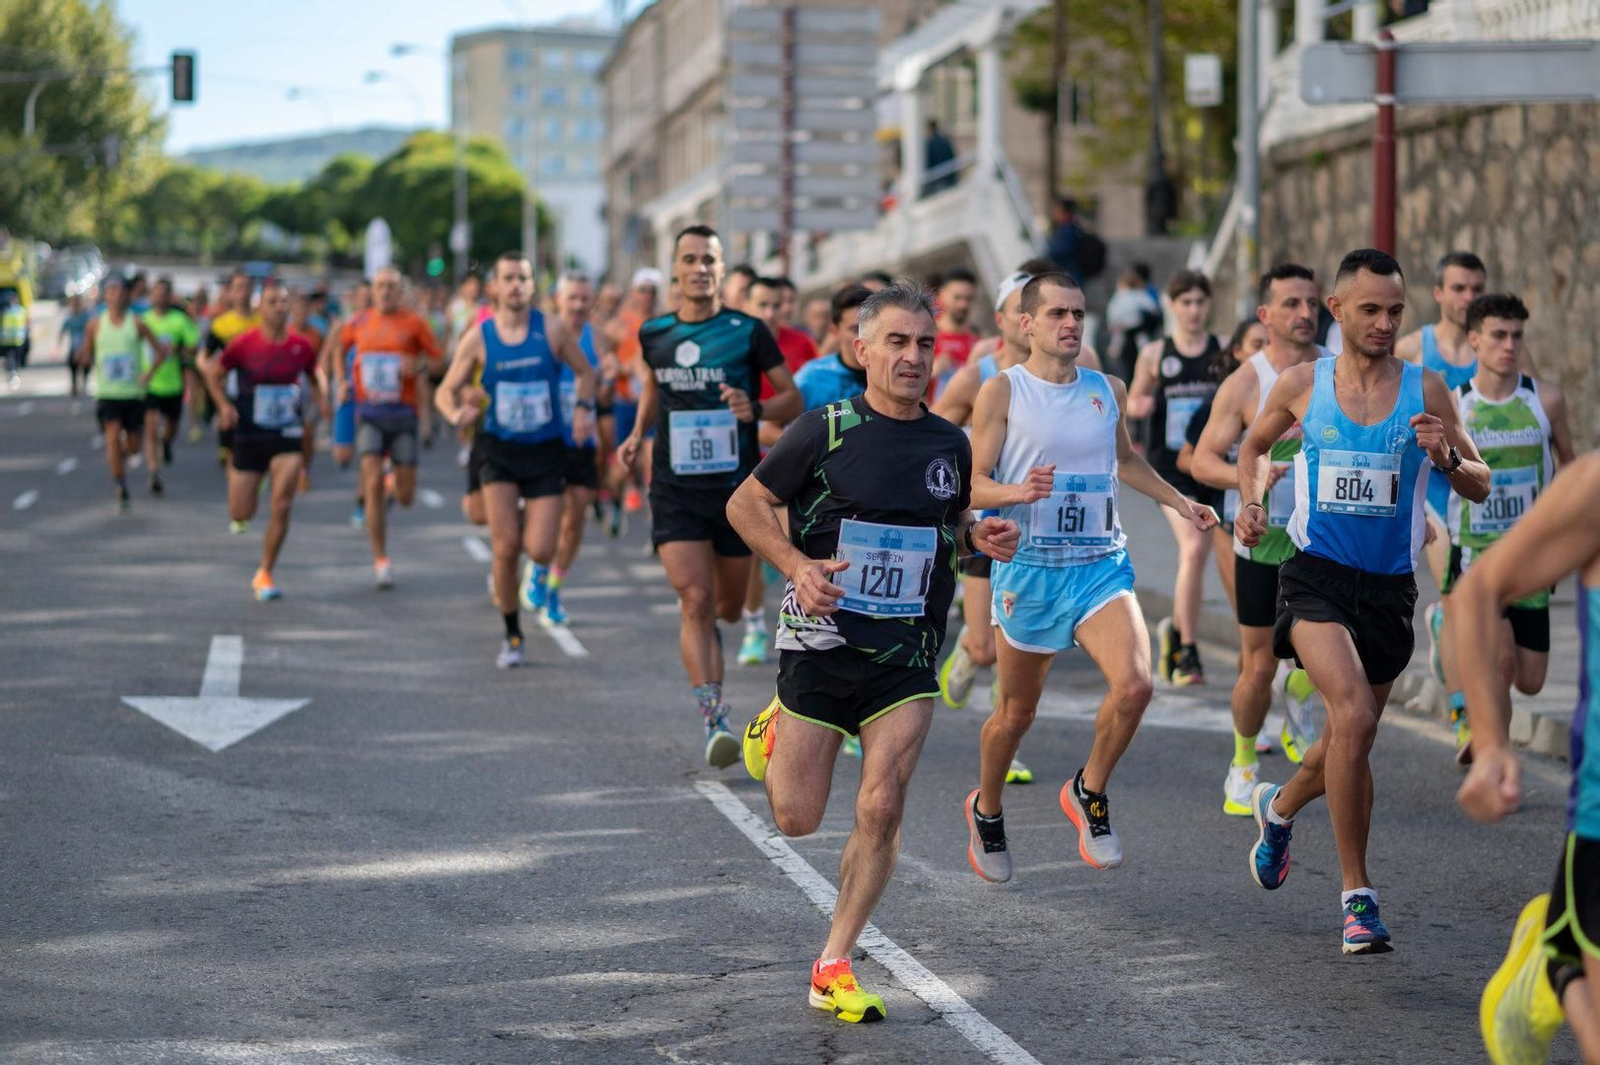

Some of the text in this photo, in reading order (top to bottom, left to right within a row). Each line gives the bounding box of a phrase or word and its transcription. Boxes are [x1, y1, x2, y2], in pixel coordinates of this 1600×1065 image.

[690, 438, 713, 460] 69
[1335, 477, 1374, 502] 804
[1057, 506, 1086, 532] 151
[1482, 496, 1524, 520] 3001
[866, 551, 904, 563] SERAFIN
[859, 564, 904, 598] 120
